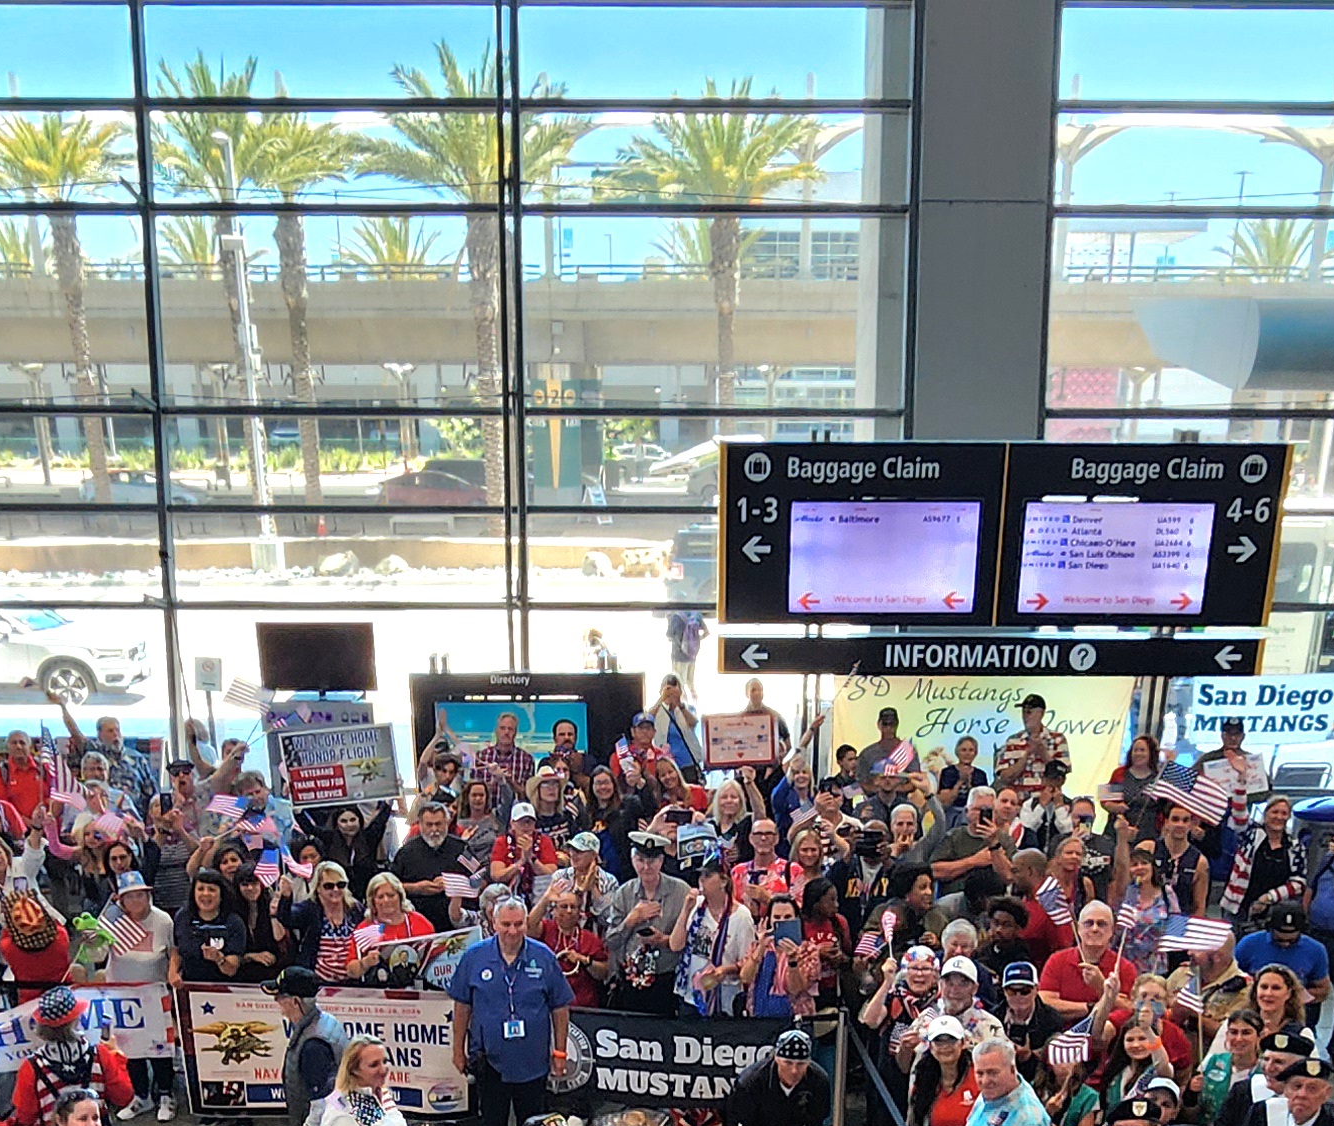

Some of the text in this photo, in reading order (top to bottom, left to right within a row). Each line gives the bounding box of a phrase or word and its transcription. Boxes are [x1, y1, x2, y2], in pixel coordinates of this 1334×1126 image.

[787, 456, 941, 484] Baggage Claim
[1070, 457, 1225, 485] Baggage Claim
[737, 496, 779, 524] 1-3
[838, 515, 880, 524] Baltimore
[1072, 515, 1104, 524] Denver
[1226, 497, 1271, 524] 4-6
[1071, 527, 1103, 536] Atlanta
[1069, 550, 1085, 559] San
[1087, 550, 1104, 559] Luis
[1068, 561, 1084, 570] San
[833, 594, 927, 606] Welcome to San Diego
[1063, 595, 1156, 607] Welcome to San Diego
[884, 644, 1059, 668] INFORMATION
[490, 675, 530, 687] Directory
[905, 678, 1025, 713] Mustangs
[1197, 683, 1334, 712] San Diego
[915, 706, 1011, 738] Horse
[1193, 714, 1329, 733] MTANGS
[291, 729, 380, 750] WELCOME HOME
[299, 745, 378, 764] HONOR FLIGHT
[299, 767, 335, 778] VETERANS
[294, 780, 316, 790] THANK
[317, 778, 331, 788] YOU
[298, 789, 343, 800] YOUR SERVICE
[394, 1022, 450, 1046] HOME
[595, 1029, 663, 1063] San
[596, 1067, 736, 1099] MUSTAN
